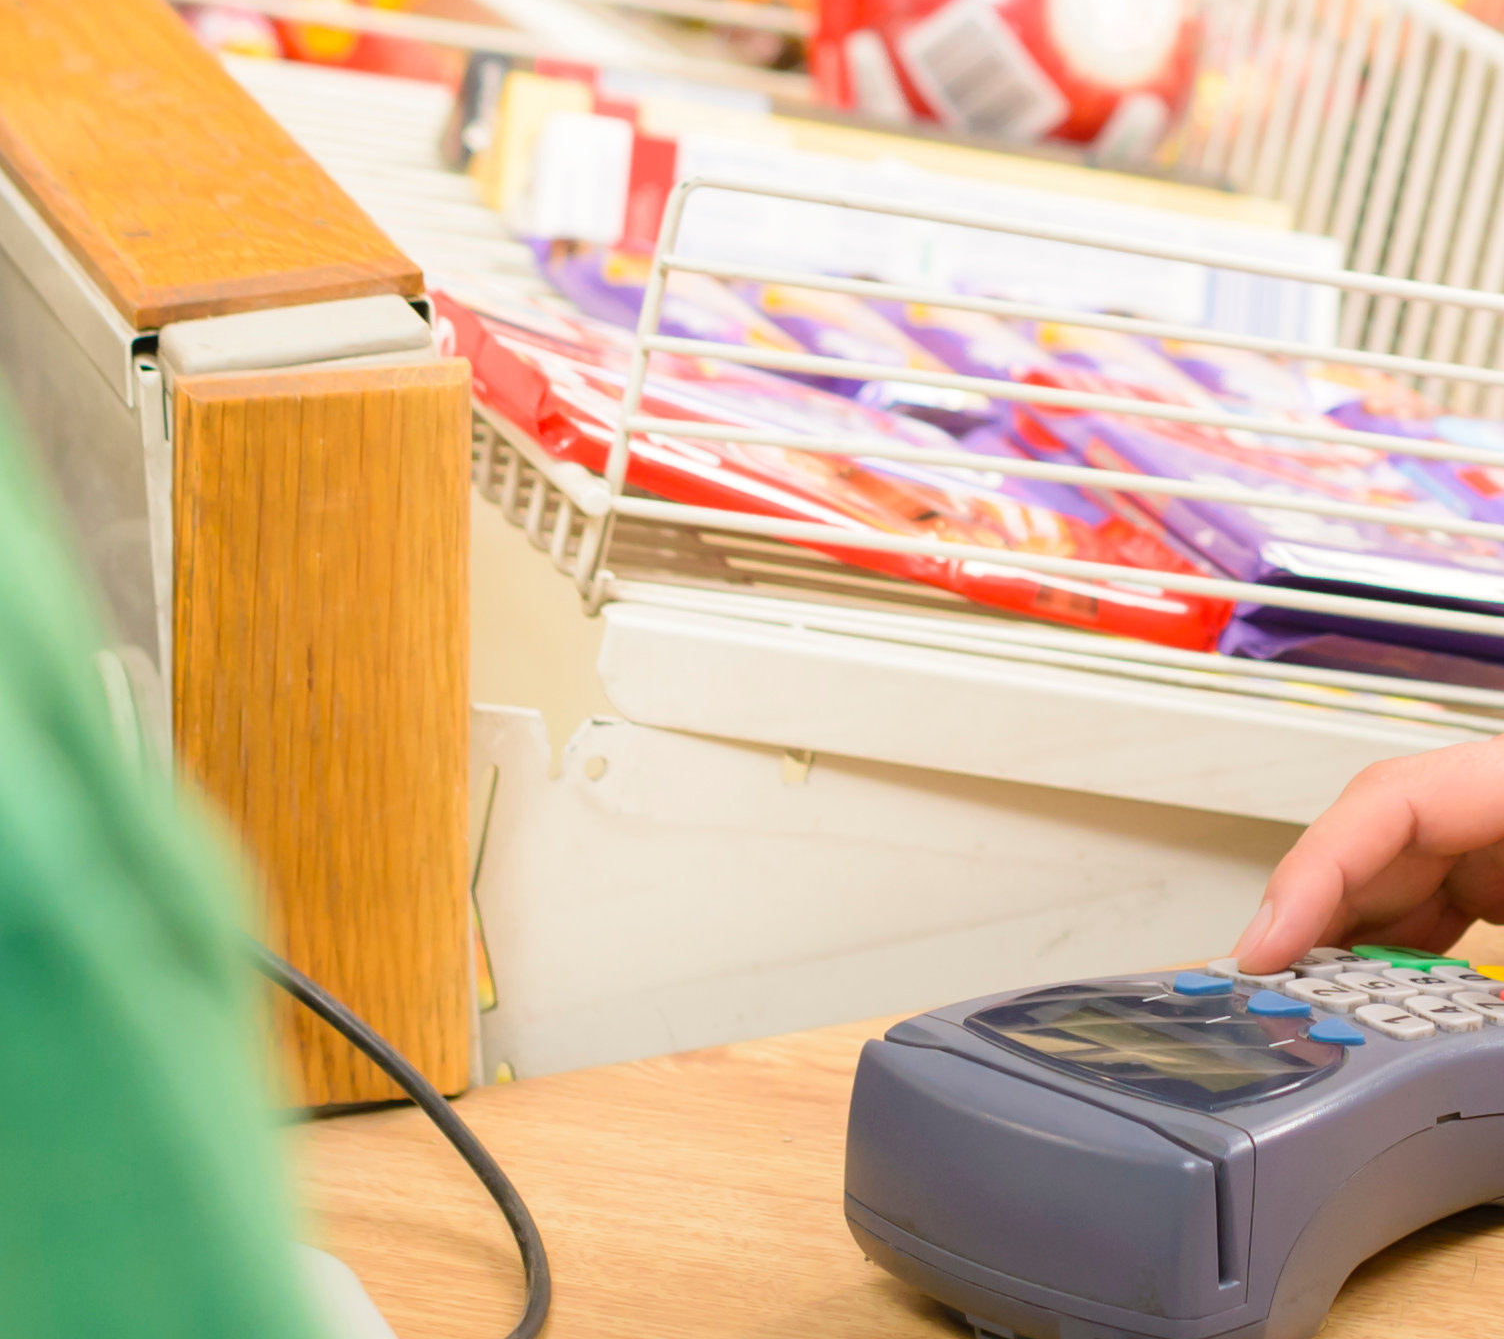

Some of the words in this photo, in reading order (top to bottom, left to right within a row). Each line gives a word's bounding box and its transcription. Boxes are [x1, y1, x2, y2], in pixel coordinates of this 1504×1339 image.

[1409, 976, 1446, 984] 8
[1359, 981, 1395, 990] 5
[1312, 986, 1350, 996] 2
[1429, 1005, 1462, 1013] 4
[1381, 1015, 1412, 1024] 1
